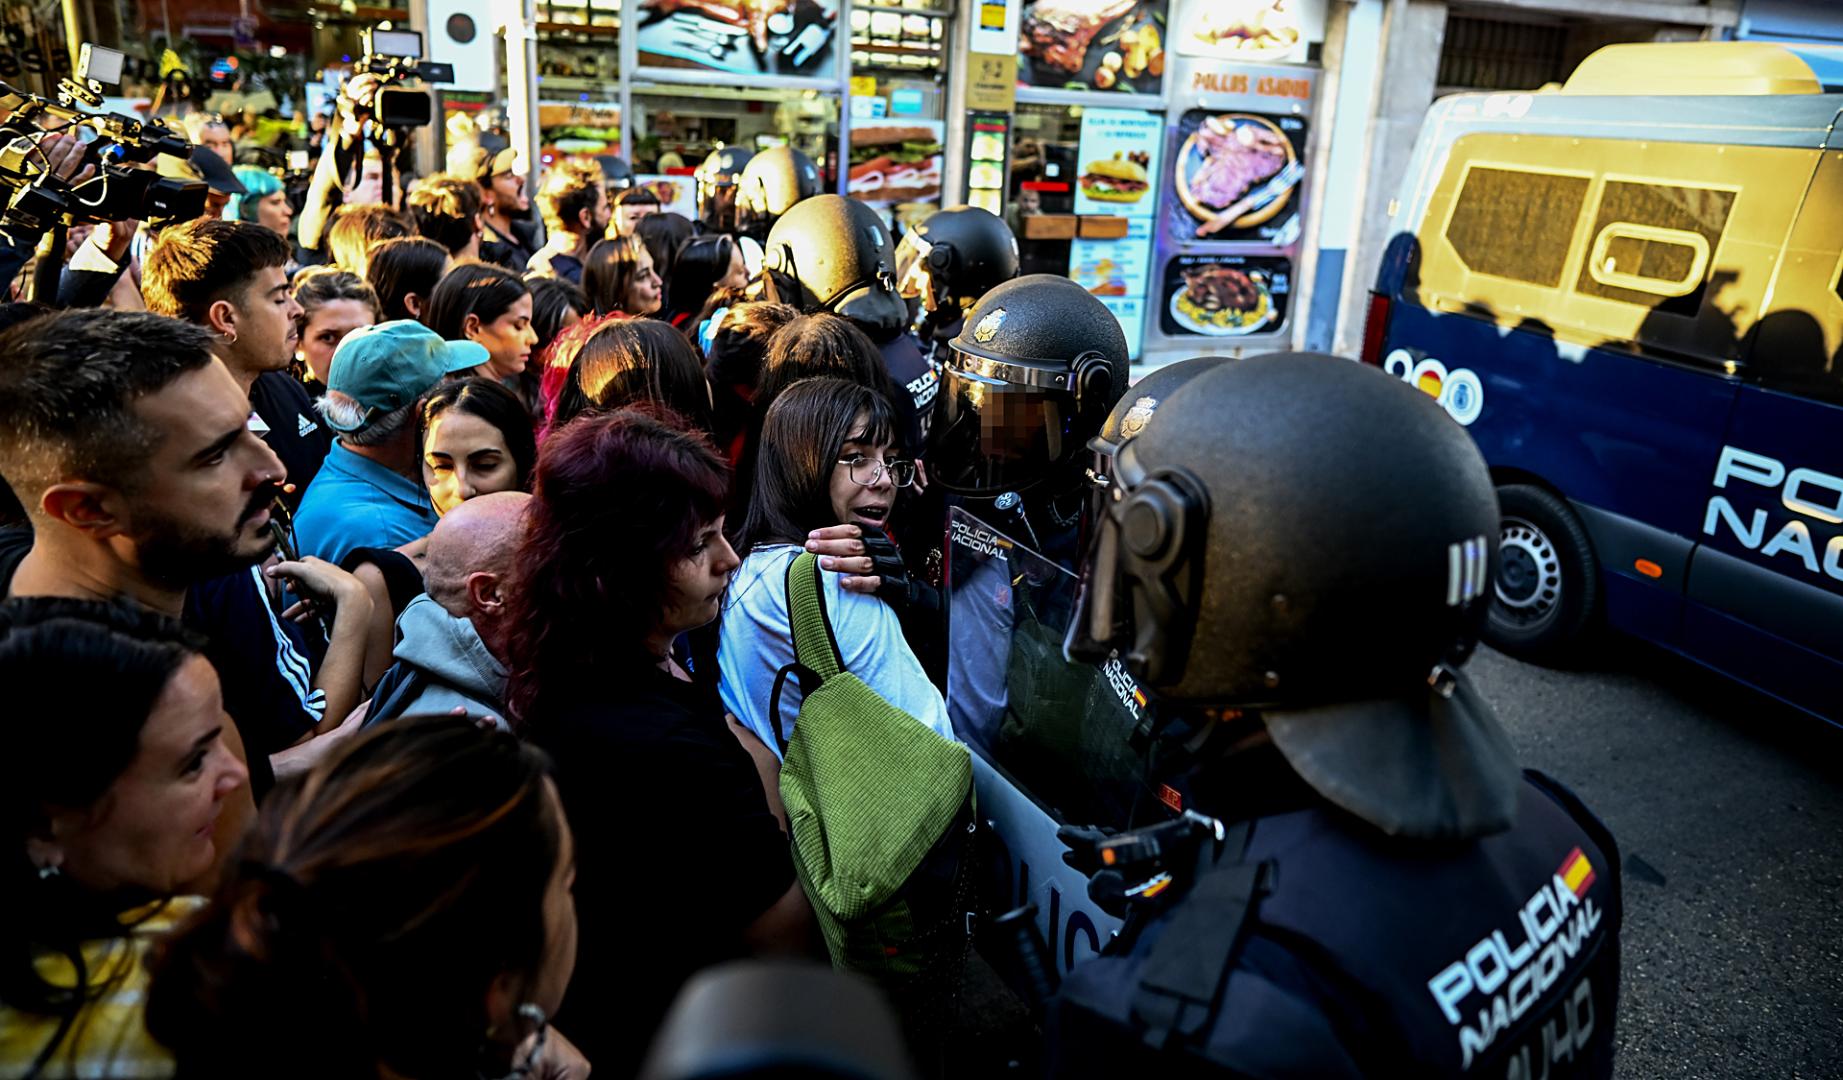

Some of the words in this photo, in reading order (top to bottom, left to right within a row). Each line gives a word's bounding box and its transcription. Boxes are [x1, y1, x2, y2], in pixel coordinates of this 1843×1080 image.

[1713, 445, 1843, 524] PO
[951, 520, 998, 546] POLICIA
[1102, 661, 1139, 720] NACIONAL
[1427, 873, 1580, 1025] POLICIA
[1458, 897, 1602, 1073] NACIONAL
